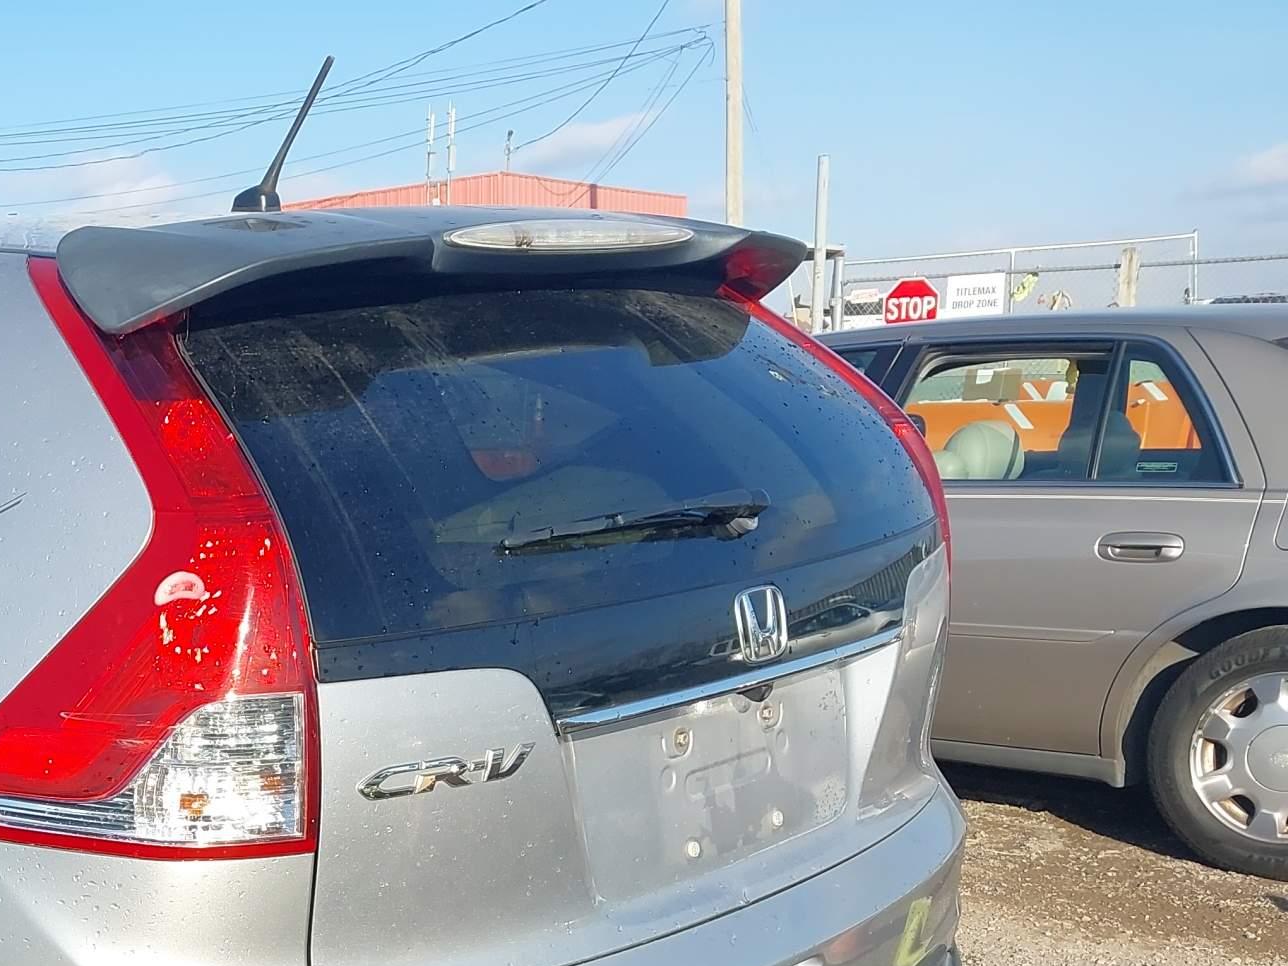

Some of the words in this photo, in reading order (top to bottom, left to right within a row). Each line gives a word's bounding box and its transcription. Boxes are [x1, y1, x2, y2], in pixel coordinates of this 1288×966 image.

[956, 286, 997, 297] TITLEMAX
[886, 296, 936, 320] STOP
[952, 300, 975, 310] DROP
[976, 298, 999, 309] ZONE
[355, 742, 537, 801] CR-V
